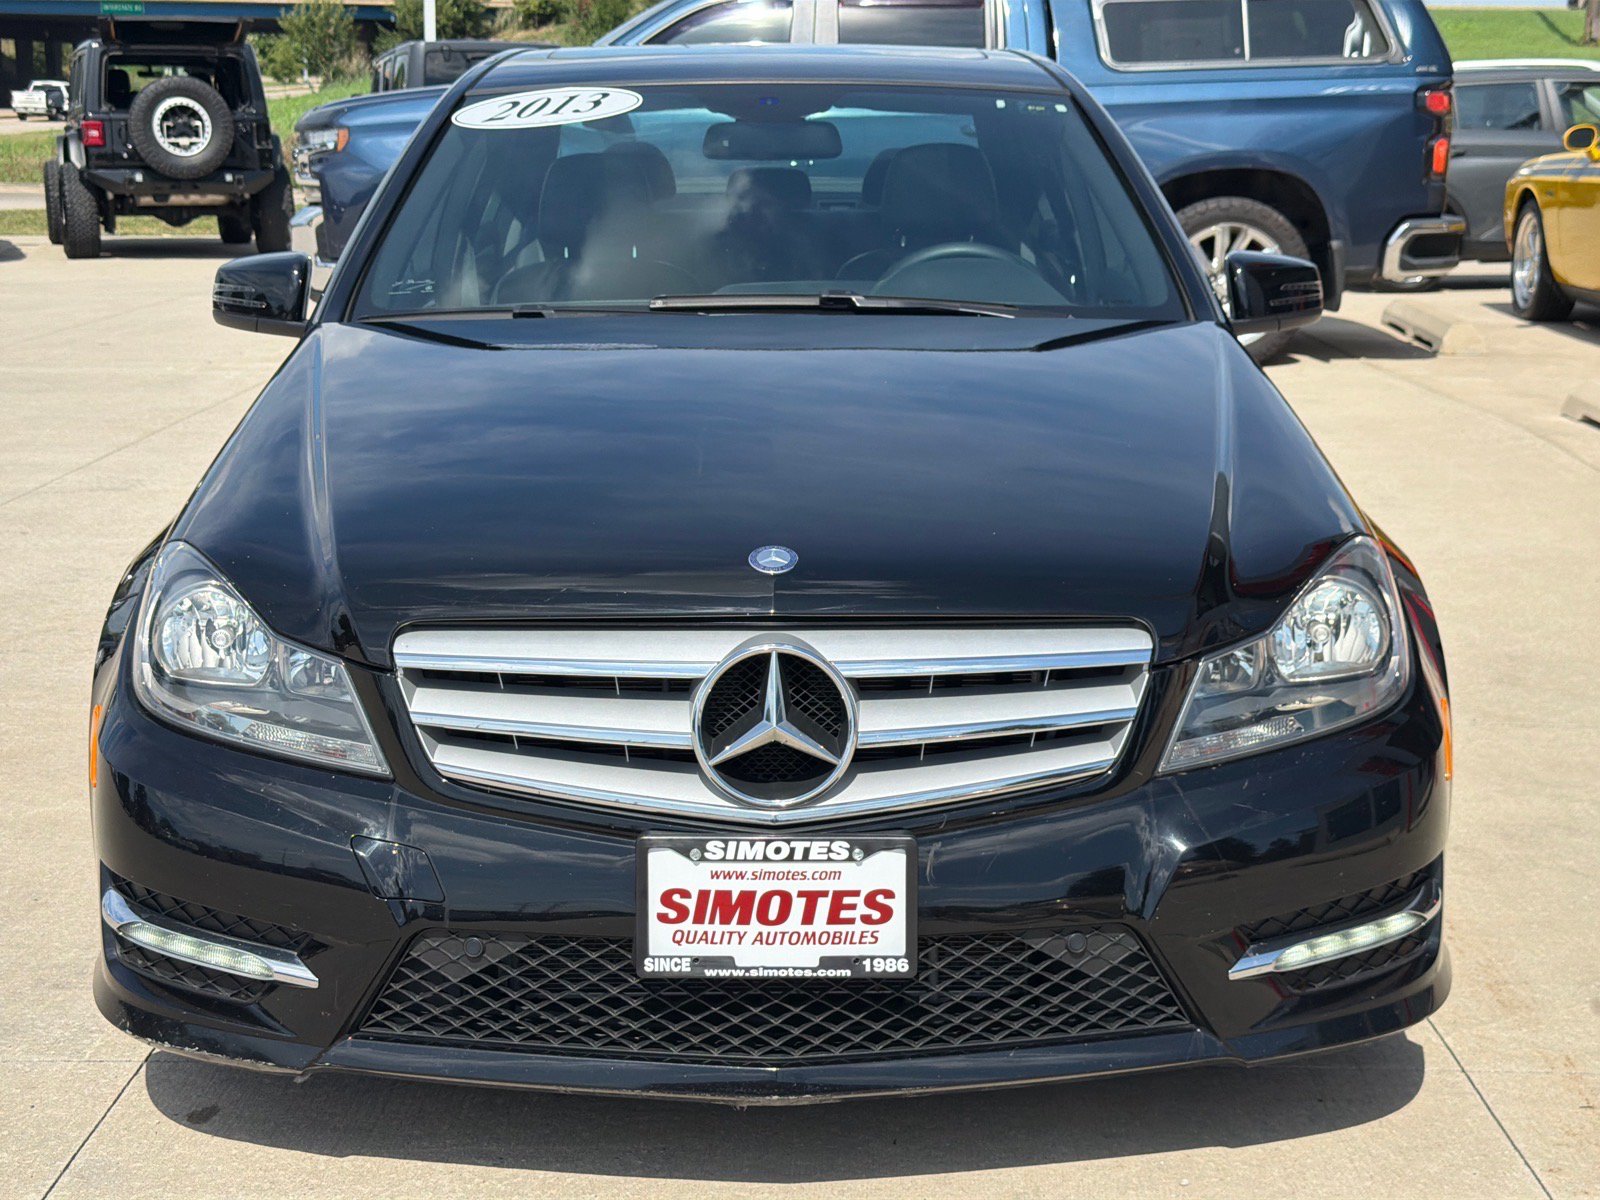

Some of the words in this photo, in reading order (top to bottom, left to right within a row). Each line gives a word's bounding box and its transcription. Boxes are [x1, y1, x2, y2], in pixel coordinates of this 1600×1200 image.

[481, 92, 610, 122] 2013
[704, 840, 850, 861] SIMOTES
[710, 868, 842, 881] www.simotes.com
[656, 888, 896, 926] SIMOTES
[671, 929, 747, 946] QUALITY
[751, 930, 879, 946] AUTOMOBILES
[643, 957, 691, 972] SINCE
[704, 968, 851, 977] www.simotes.com
[862, 958, 909, 973] 1986
